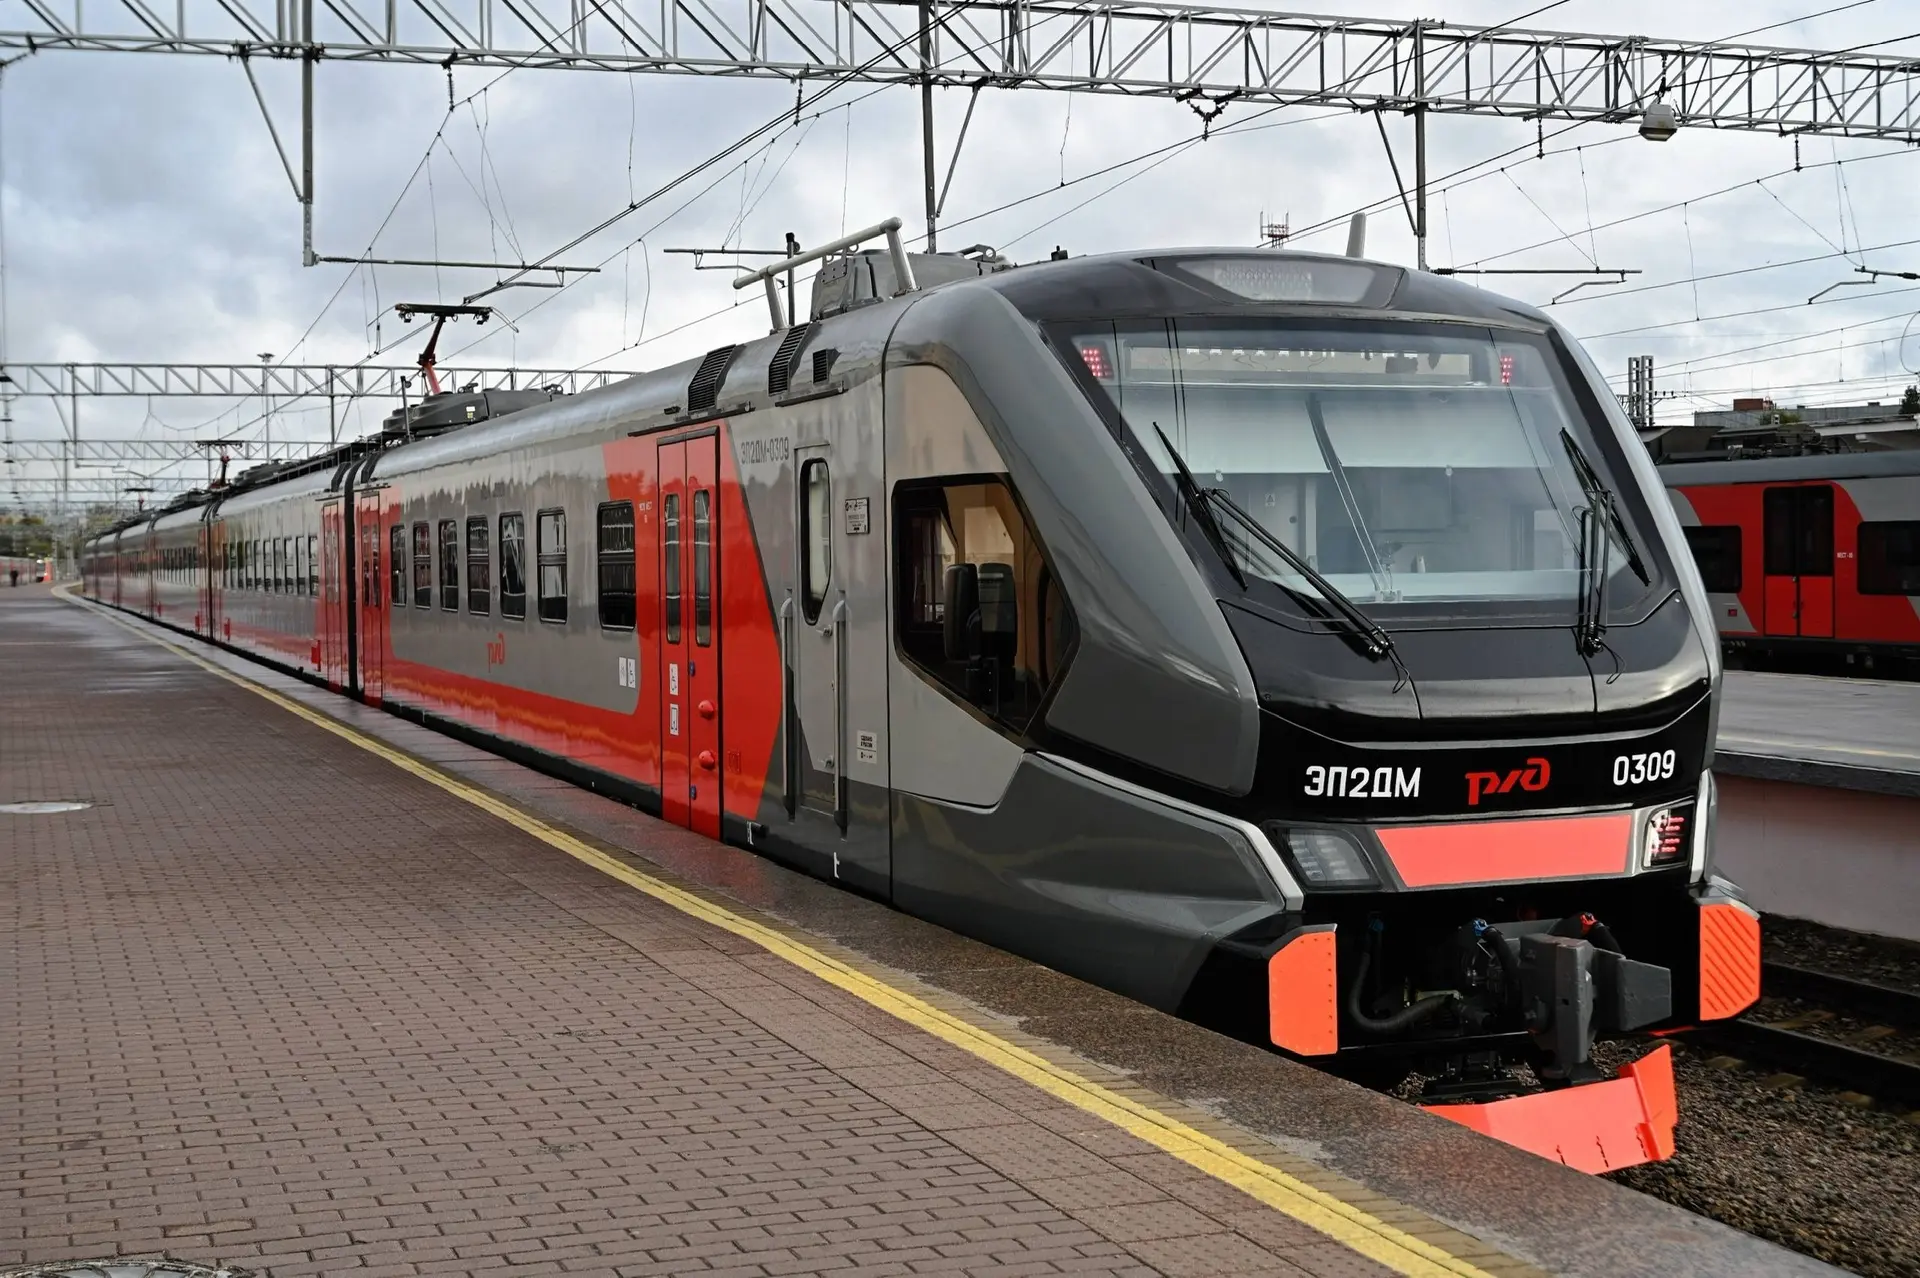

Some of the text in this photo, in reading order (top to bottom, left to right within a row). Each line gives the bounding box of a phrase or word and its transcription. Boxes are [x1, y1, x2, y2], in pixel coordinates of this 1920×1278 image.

[741, 437, 789, 464] ЭП2ДМ-0309
[1304, 765, 1421, 797] ЭП2ДМ
[1613, 749, 1676, 786] 0309
